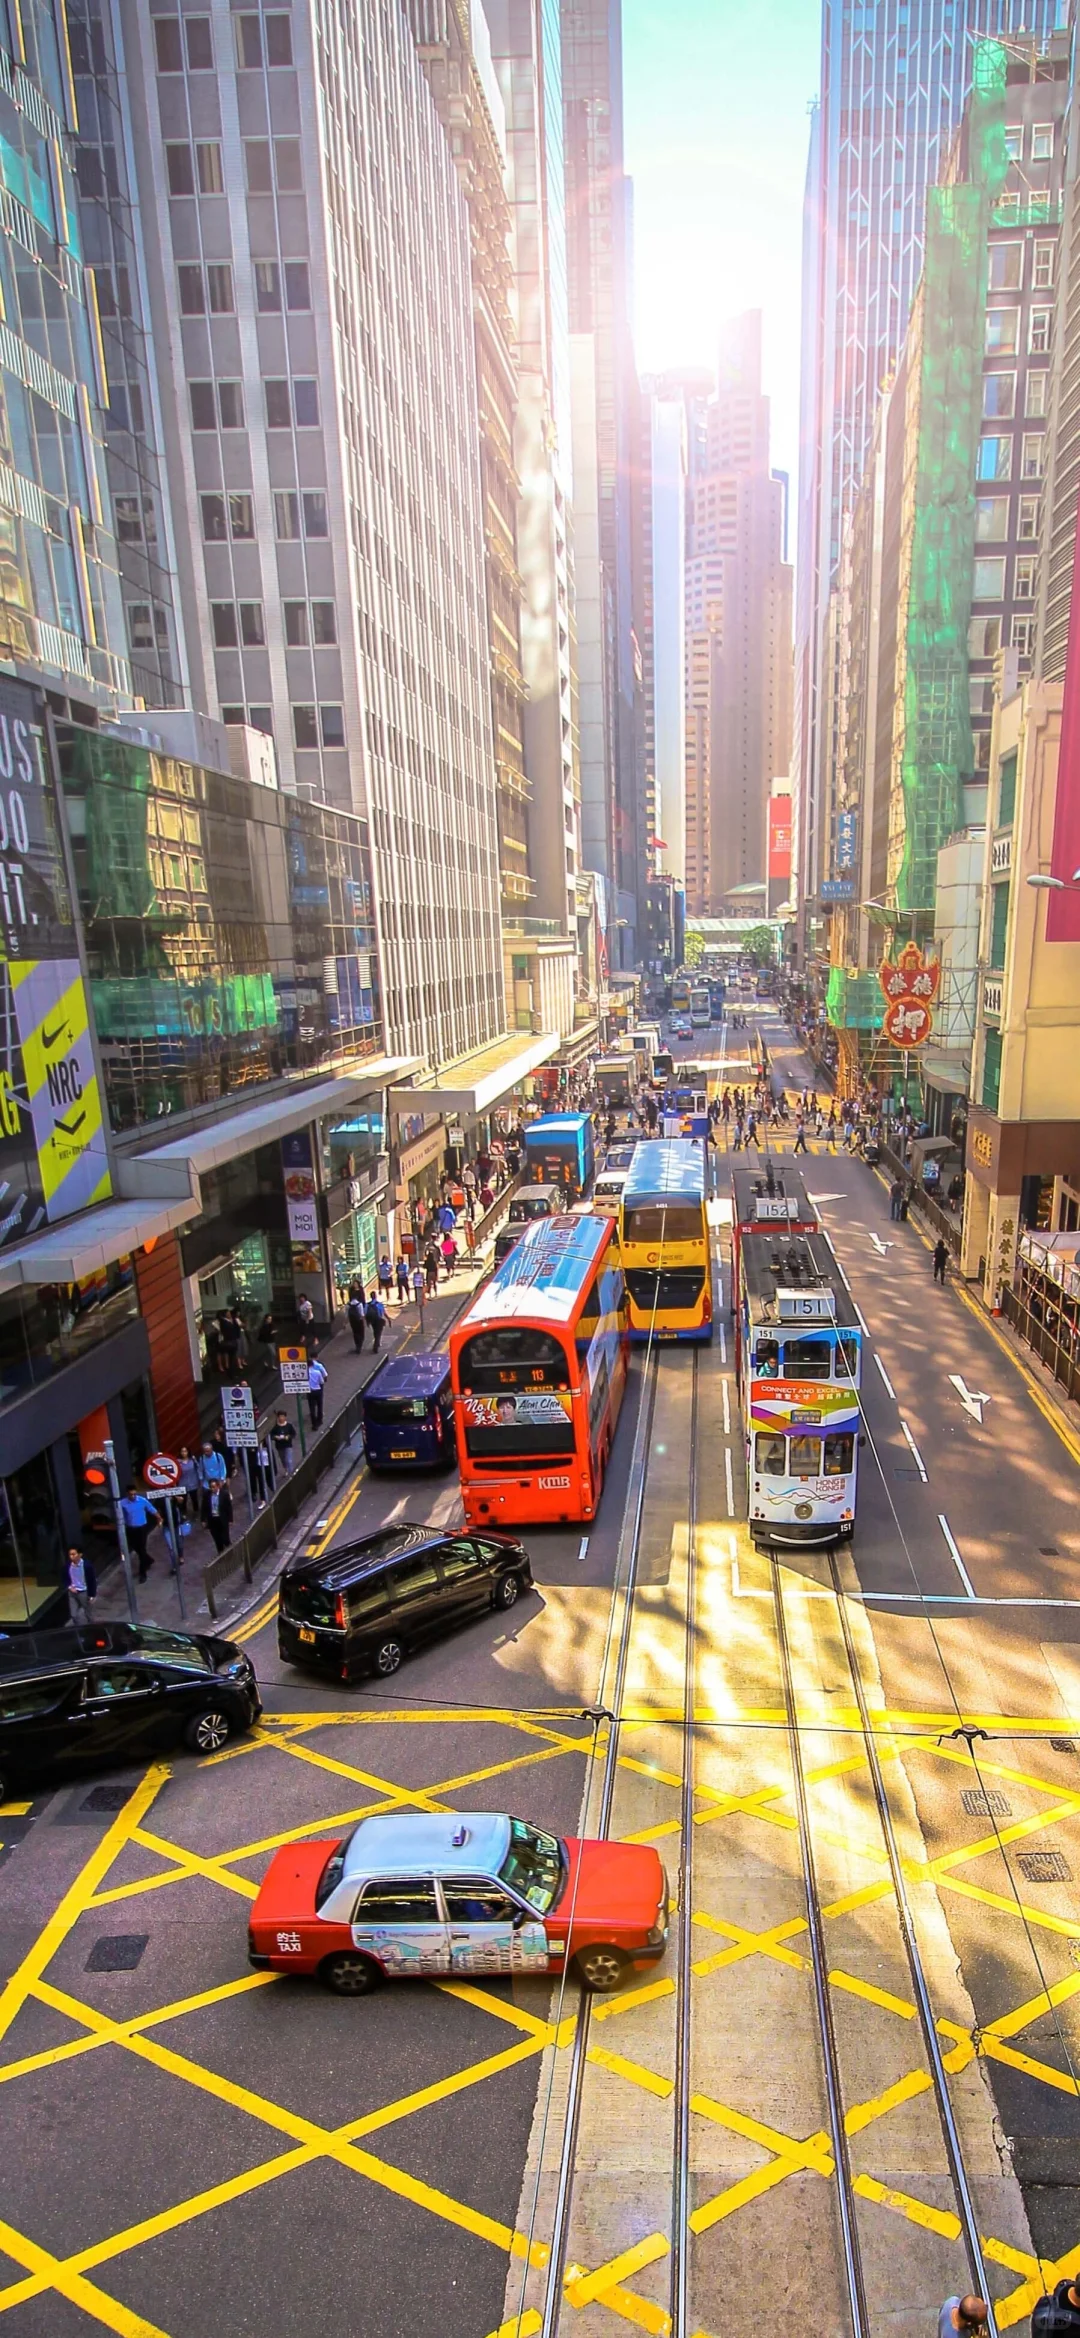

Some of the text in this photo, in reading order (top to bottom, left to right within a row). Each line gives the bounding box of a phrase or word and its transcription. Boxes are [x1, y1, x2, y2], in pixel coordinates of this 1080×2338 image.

[891, 1004, 926, 1040] 押
[46, 1058, 82, 1107] NRC
[766, 1205, 788, 1216] 152
[294, 1214, 313, 1223] MOI
[295, 1223, 313, 1231] MOI
[793, 1300, 821, 1314] 151
[532, 1369, 545, 1381] 113
[464, 1398, 493, 1413] No.1
[474, 1411, 500, 1425] 英文
[538, 1476, 571, 1490] KMB
[815, 1478, 840, 1486] HONG
[840, 1523, 852, 1532] 151
[276, 1931, 300, 1943] 的士
[278, 1942, 302, 1952] TAXI
